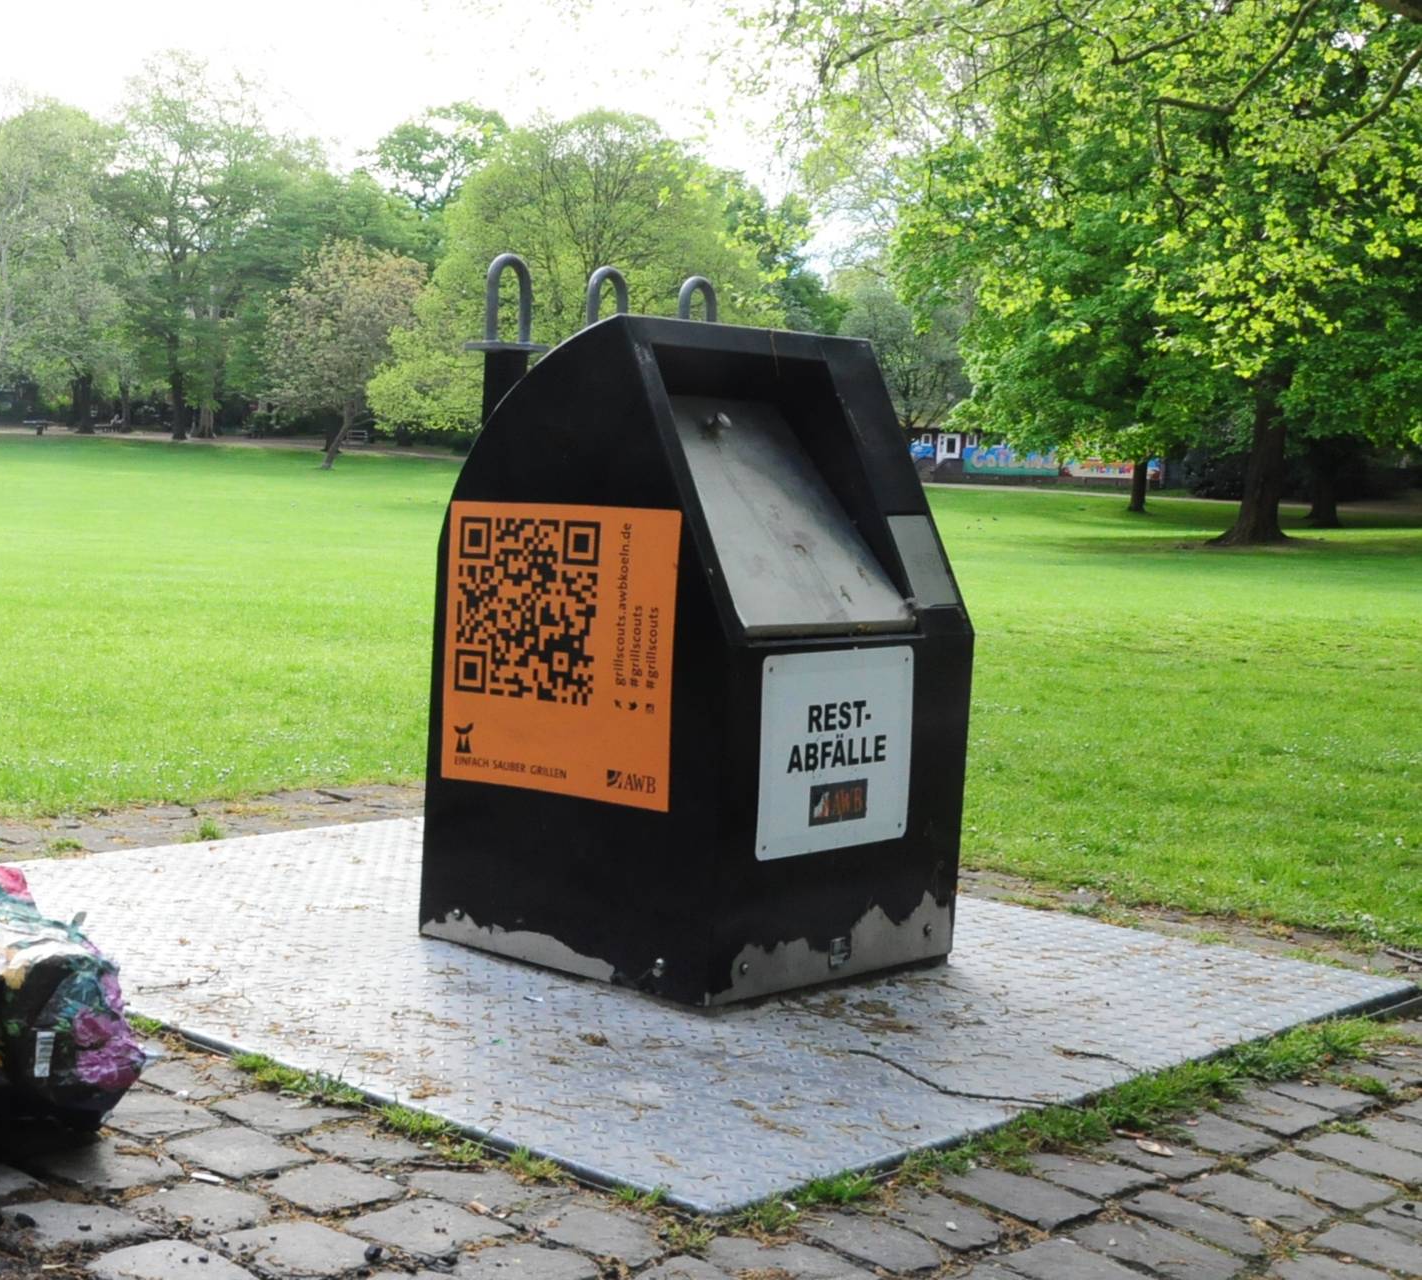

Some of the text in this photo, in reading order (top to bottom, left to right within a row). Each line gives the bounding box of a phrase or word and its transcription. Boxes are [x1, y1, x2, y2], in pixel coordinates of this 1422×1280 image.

[613, 521, 632, 687] grillscouts.awbkoeln.de
[629, 604, 643, 688] #grillscouts
[645, 606, 659, 690] #grillscouts
[807, 700, 872, 733] REST-
[453, 755, 567, 780] EINFACH SAUBER GRILLEN
[786, 733, 887, 774] ABFÄLLE
[624, 774, 657, 795] AWB
[833, 787, 864, 816] AWB
